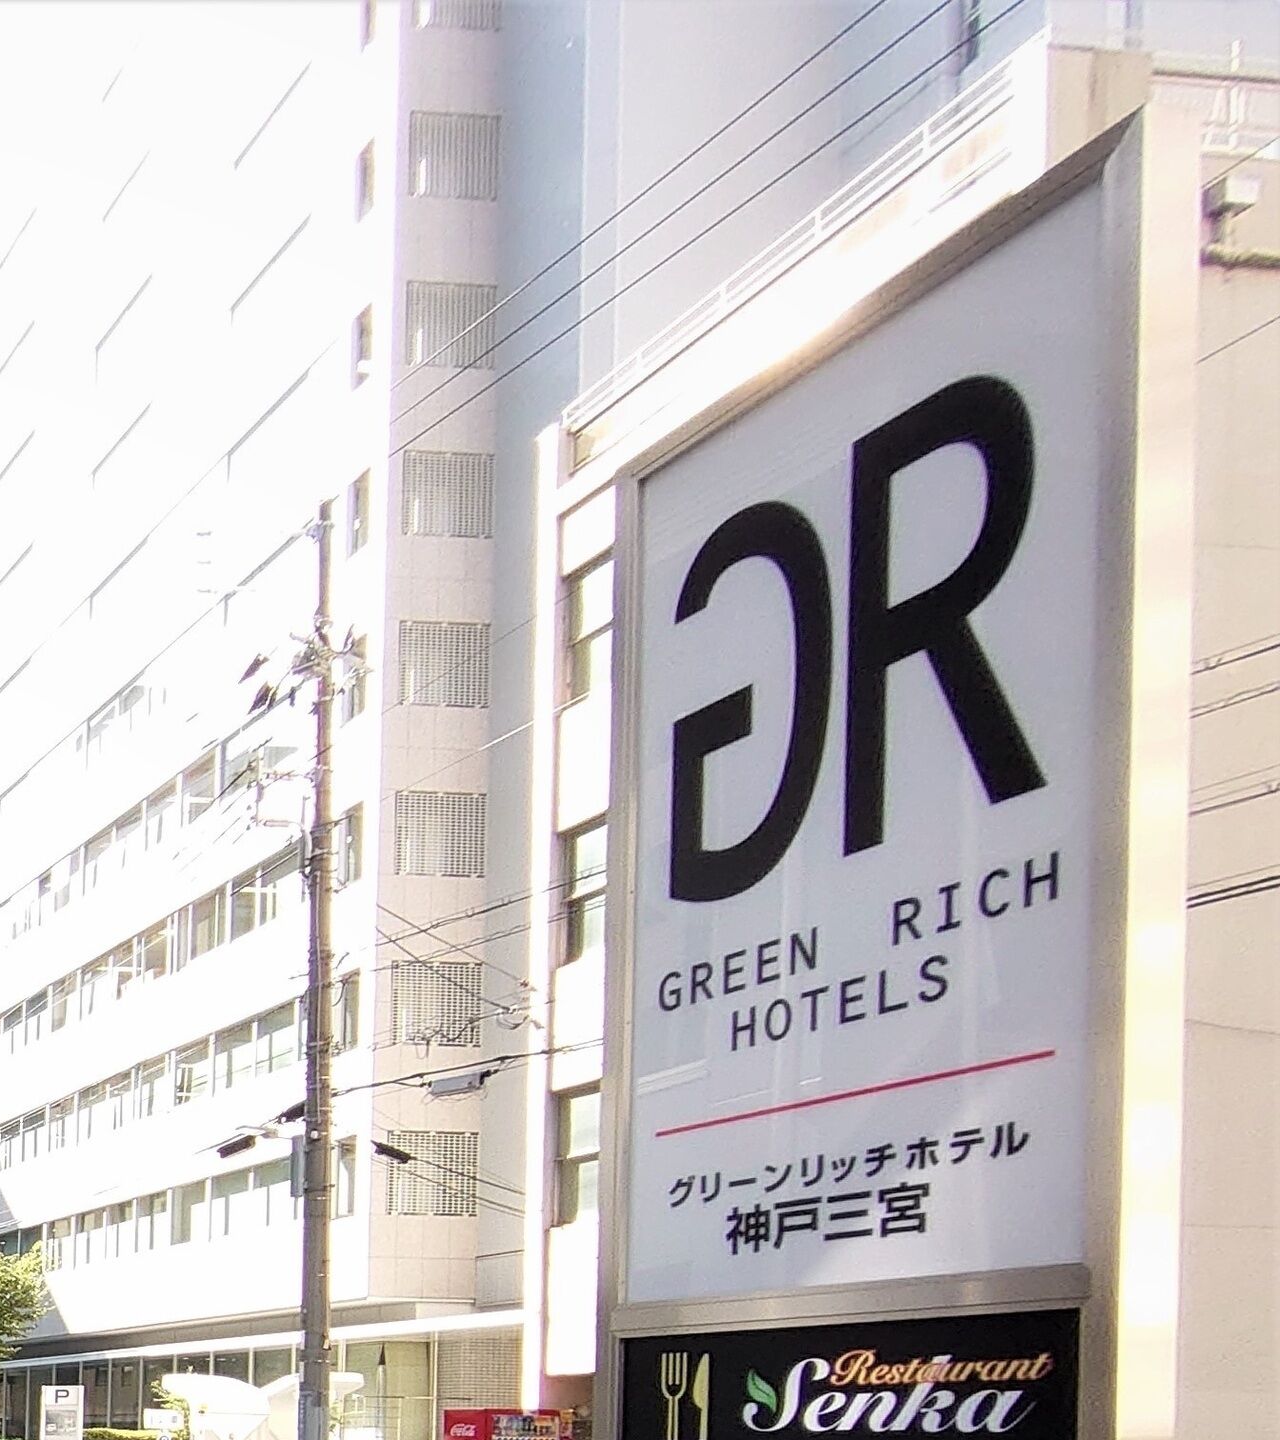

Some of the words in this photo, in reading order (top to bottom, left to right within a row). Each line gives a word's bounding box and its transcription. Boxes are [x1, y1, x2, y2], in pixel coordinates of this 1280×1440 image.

[658, 927, 819, 1012] GREEN
[892, 852, 1060, 945] RICH
[730, 954, 951, 1052] HOTELS
[668, 1121, 1029, 1207] グリーンリッチホテル
[725, 1182, 930, 1255] 神戸三宮
[55, 1389, 70, 1403] P
[743, 1354, 1038, 1434] Senka
[831, 1349, 1054, 1387] Restaurant
